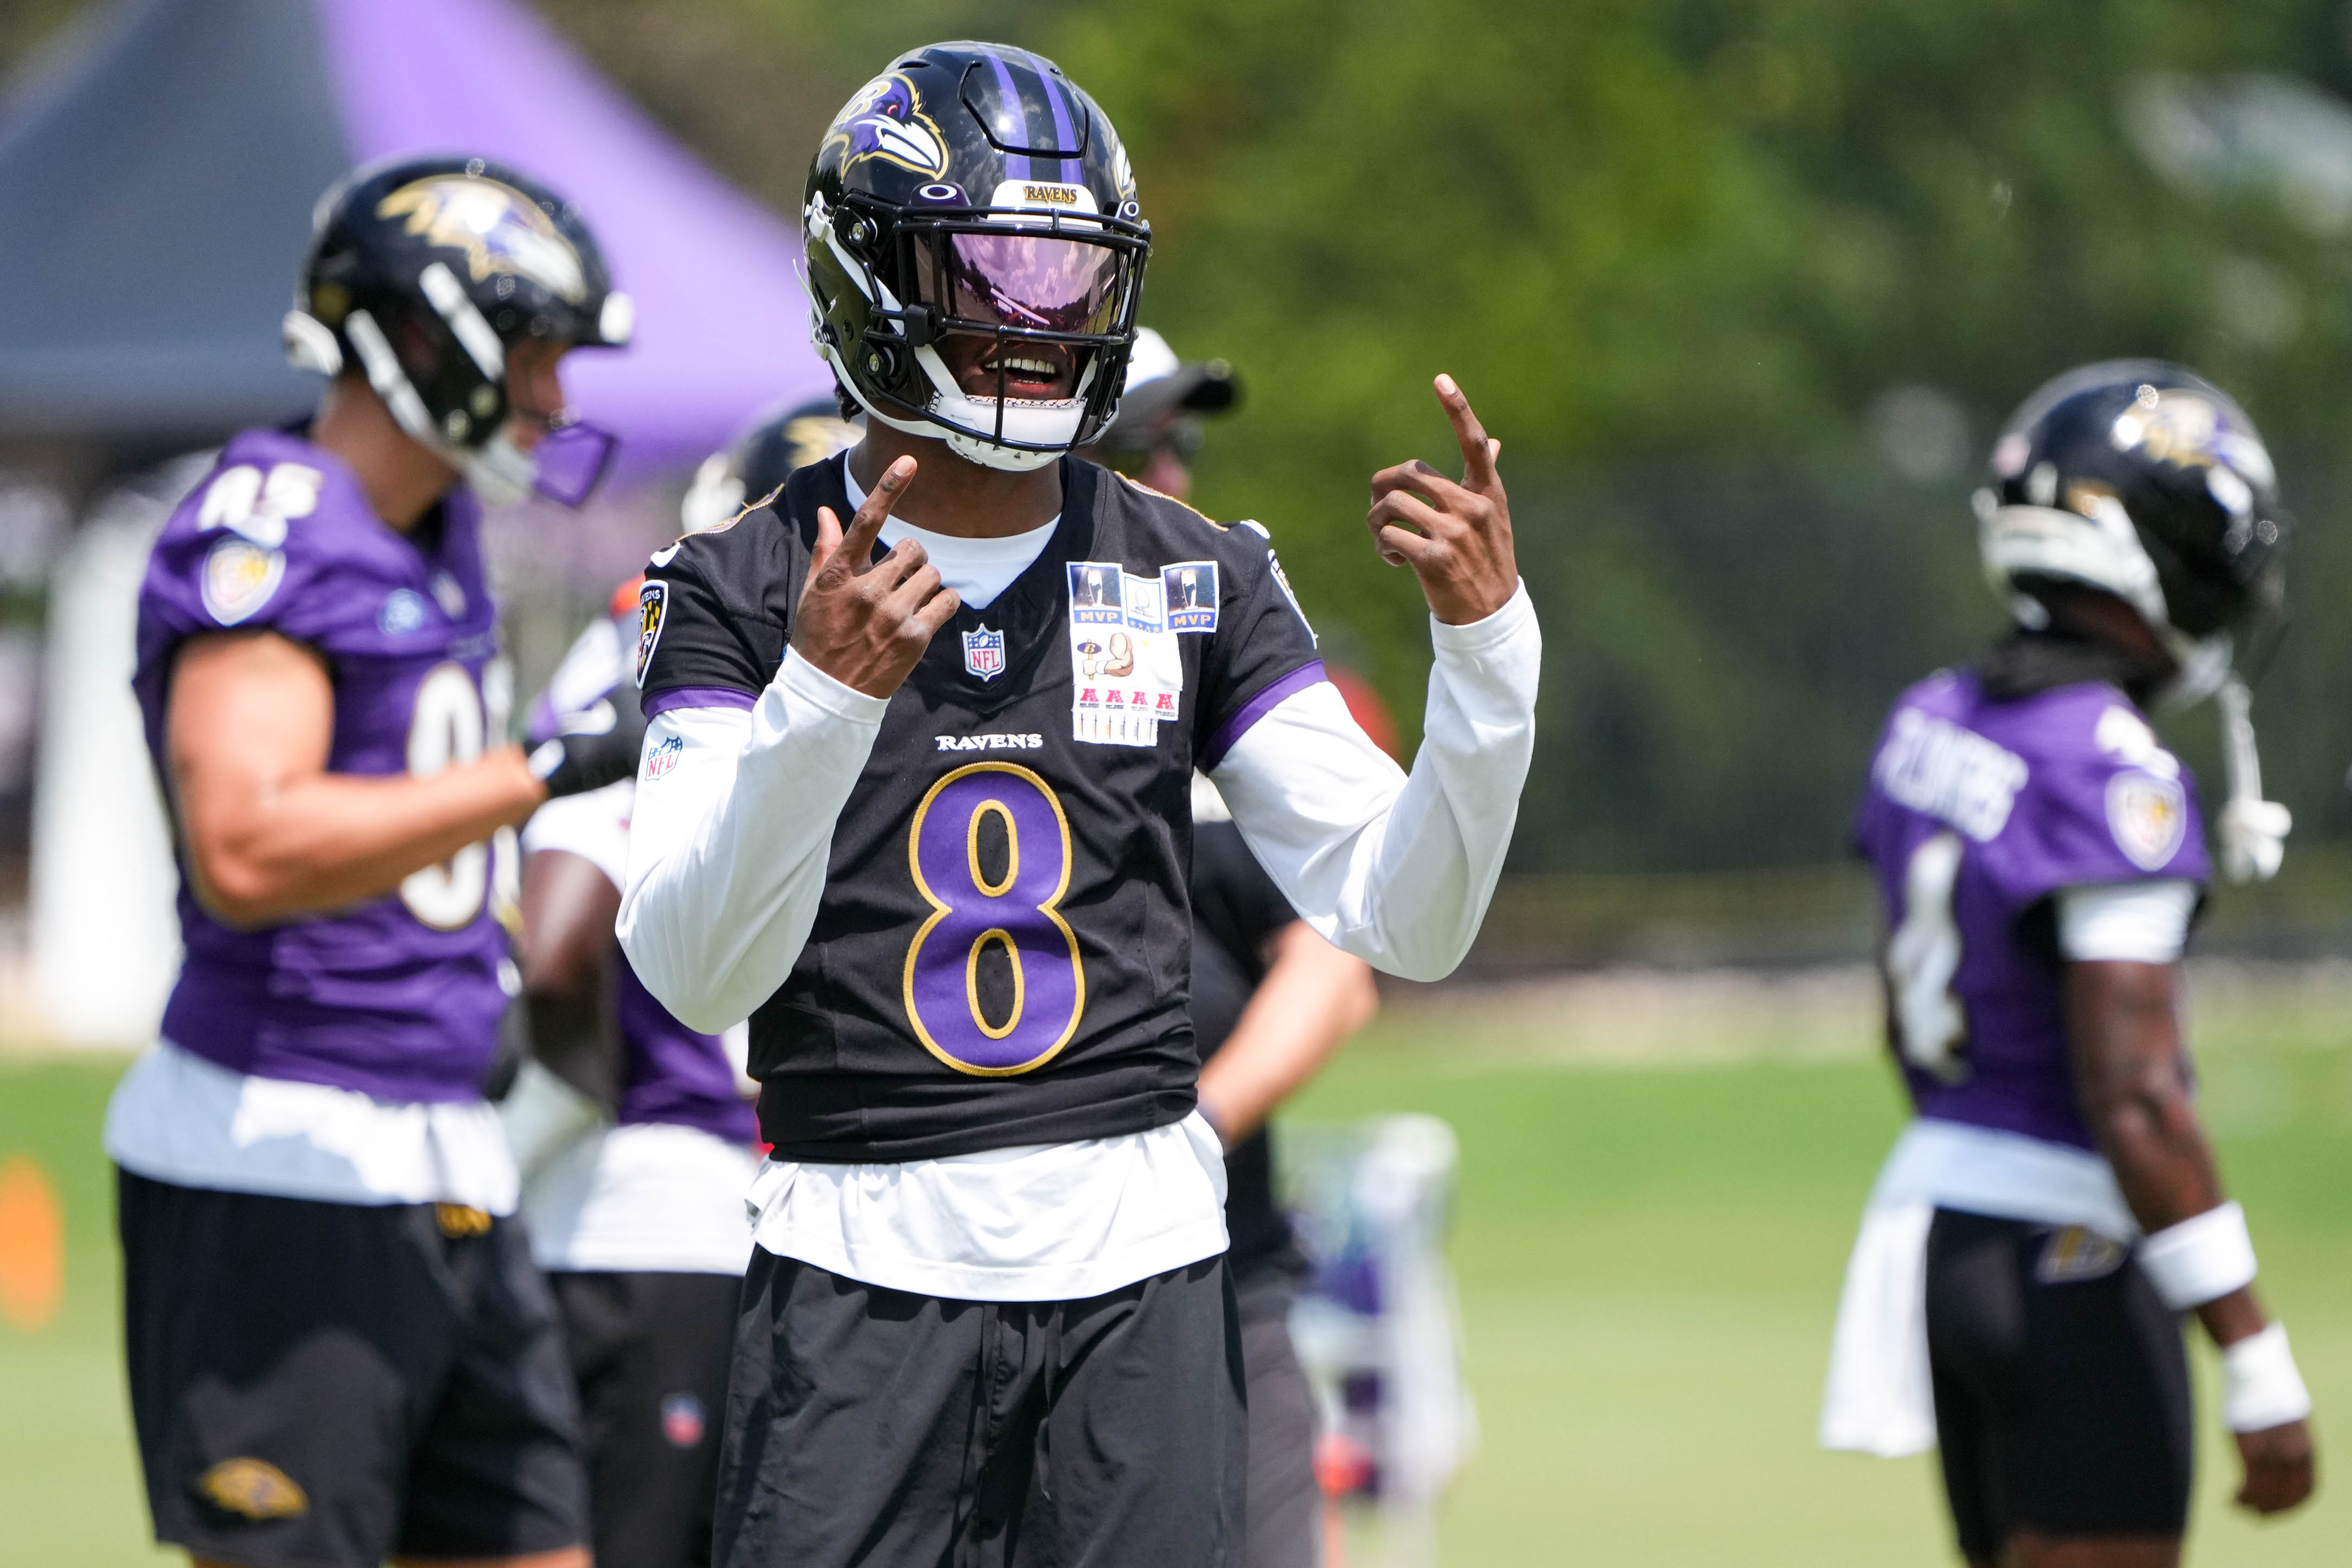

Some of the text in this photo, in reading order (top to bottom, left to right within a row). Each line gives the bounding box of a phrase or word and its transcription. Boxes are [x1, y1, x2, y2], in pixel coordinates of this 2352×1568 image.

[1024, 185, 1077, 203] RAVENS
[1081, 611, 1118, 622] MVP
[1174, 614, 1211, 626] MVP
[972, 650, 999, 670] NFL
[935, 733, 1043, 751] RAVENS
[648, 754, 674, 777] NFL
[903, 761, 1085, 1077] 8
